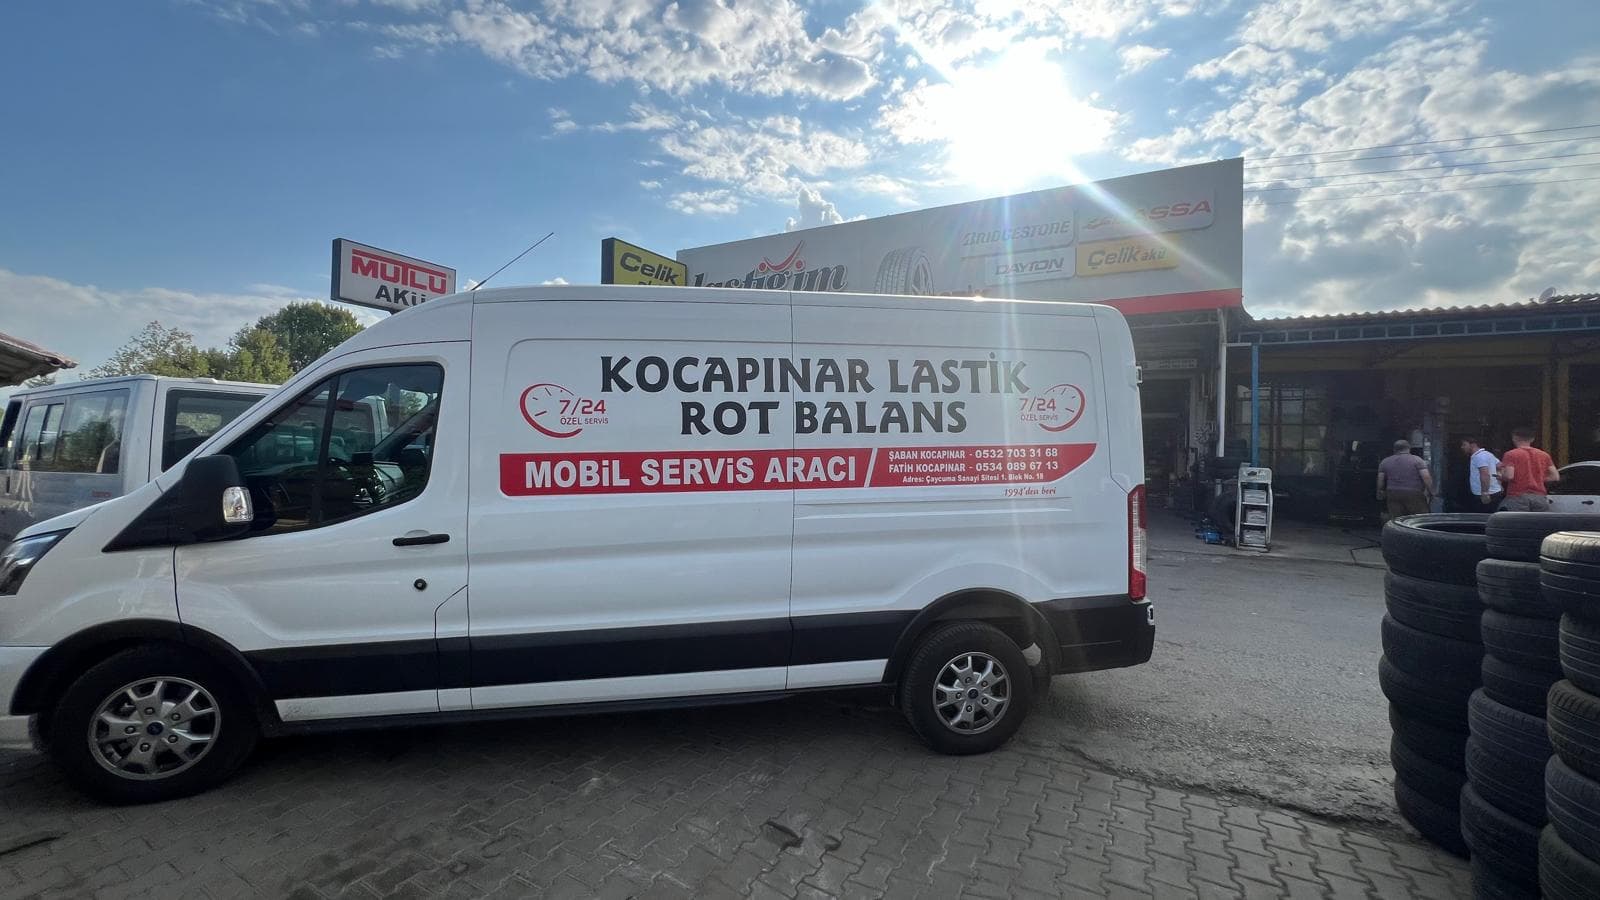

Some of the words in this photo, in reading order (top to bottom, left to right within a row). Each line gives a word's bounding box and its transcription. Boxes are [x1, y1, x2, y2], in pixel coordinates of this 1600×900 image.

[963, 220, 1072, 246] BRIDGESTONE
[352, 249, 447, 295] MUTLU
[995, 257, 1065, 277] DAYTON
[600, 356, 876, 393] KOCAPINAR
[888, 352, 1031, 394] LASTİK
[559, 398, 606, 415] 7/24
[1019, 396, 1056, 411] 7/24
[560, 415, 582, 425] ÖZEL
[681, 401, 780, 436] ROT
[795, 401, 968, 434] BALANS
[889, 451, 917, 461] ŞABAN
[920, 450, 966, 460] KOCAPINAR
[975, 448, 1004, 459] 0532
[1007, 448, 1026, 458] 703
[1029, 447, 1041, 458] 31
[1045, 447, 1058, 457] 68
[764, 456, 856, 484] ARACI
[916, 463, 966, 472] KOCAPINAR
[975, 462, 1003, 472] 0534
[1006, 462, 1026, 471] 089
[1029, 461, 1042, 471] 67
[1046, 461, 1058, 470] 13
[903, 475, 924, 483] Adres:
[926, 475, 956, 484] Çaycuma
[957, 474, 980, 483] Sanayi
[980, 473, 1000, 482] Sitesi
[1001, 473, 1007, 481] 1.
[1008, 473, 1023, 481] Blok
[1024, 473, 1034, 481] No.
[1041, 486, 1057, 495] beri
